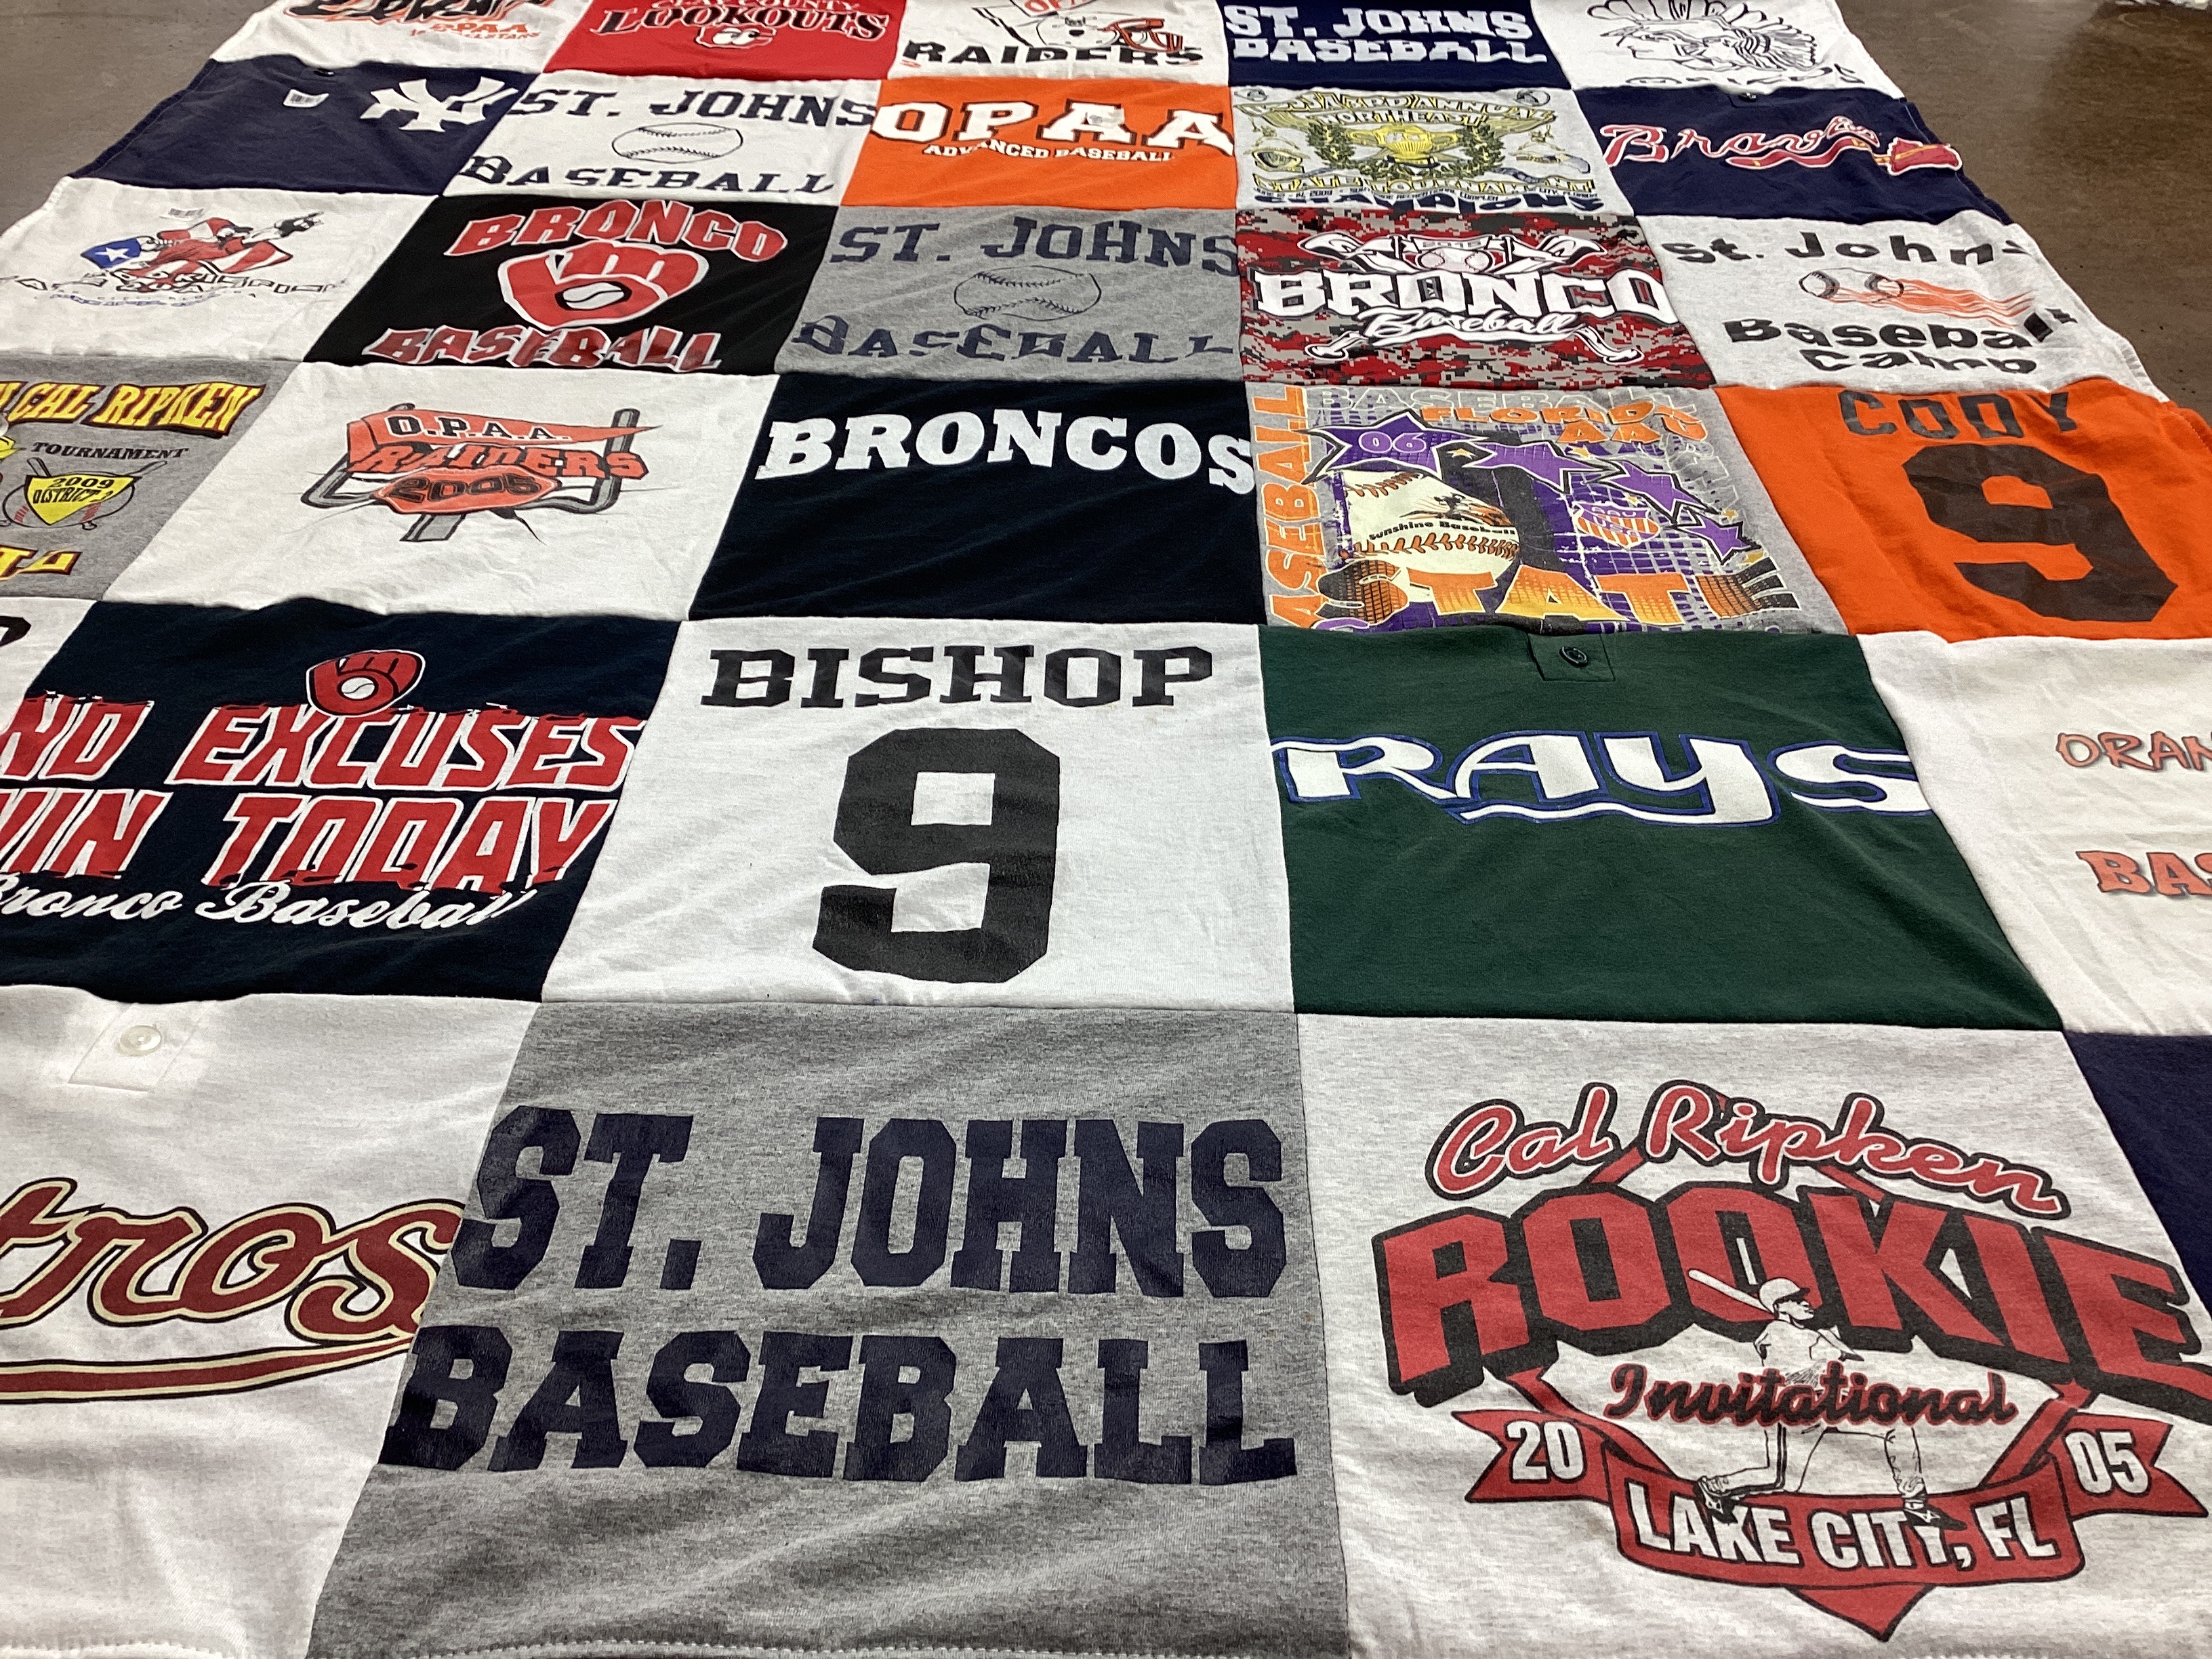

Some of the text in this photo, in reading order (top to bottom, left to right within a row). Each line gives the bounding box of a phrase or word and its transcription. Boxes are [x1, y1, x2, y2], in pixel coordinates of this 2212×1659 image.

[590, 7, 890, 41] LOOKOUTS
[1224, 5, 1534, 40] ST. JOHNS
[901, 41, 1204, 66] RAIDERS
[1233, 39, 1548, 63] BASEBALL
[507, 89, 878, 127] ST. JOHNS
[869, 99, 1235, 157] OPAA
[1316, 110, 1488, 127] NORTHEAST
[1414, 94, 1555, 121] ANNUAL
[459, 155, 835, 194] BASEBALL
[922, 140, 1172, 162] ADVANCED BASEBALL
[444, 199, 788, 262] BRONCO
[830, 217, 1238, 276] ST. JOHNS
[1251, 269, 1680, 327] BRONCO
[1357, 307, 1582, 340] Baseball
[362, 324, 721, 373] BASEBALL
[790, 314, 1235, 363] BASEBALL
[5, 381, 106, 426] CAL
[80, 381, 267, 439] RIPKEN
[1837, 390, 2078, 439] CODY
[31, 442, 190, 459] TOURNAMENT
[345, 444, 649, 480] RAIDERS
[754, 409, 1256, 495] BRONCOS
[1357, 430, 1427, 454] 06
[33, 487, 102, 504] DISTRICT
[47, 476, 116, 489] 2009
[1902, 443, 2179, 622] 9
[700, 645, 1213, 709] BISHOP
[165, 701, 648, 792] EXCUSES
[201, 792, 619, 894] TODAY
[812, 726, 1061, 984] 9
[197, 880, 539, 930] Baseball
[1425, 1079, 2072, 1221] Cal Ripken
[450, 1103, 1287, 1298] ST. JOHNS
[1371, 1181, 2212, 1426] ROOKIE
[377, 1323, 1298, 1487] BASEBALL
[1602, 1359, 2020, 1429] Invitational
[1504, 1417, 1587, 1484] 20
[2063, 1427, 2151, 1498] 05
[1625, 1480, 1804, 1569] LAKE
[1984, 1495, 2061, 1561] FL
